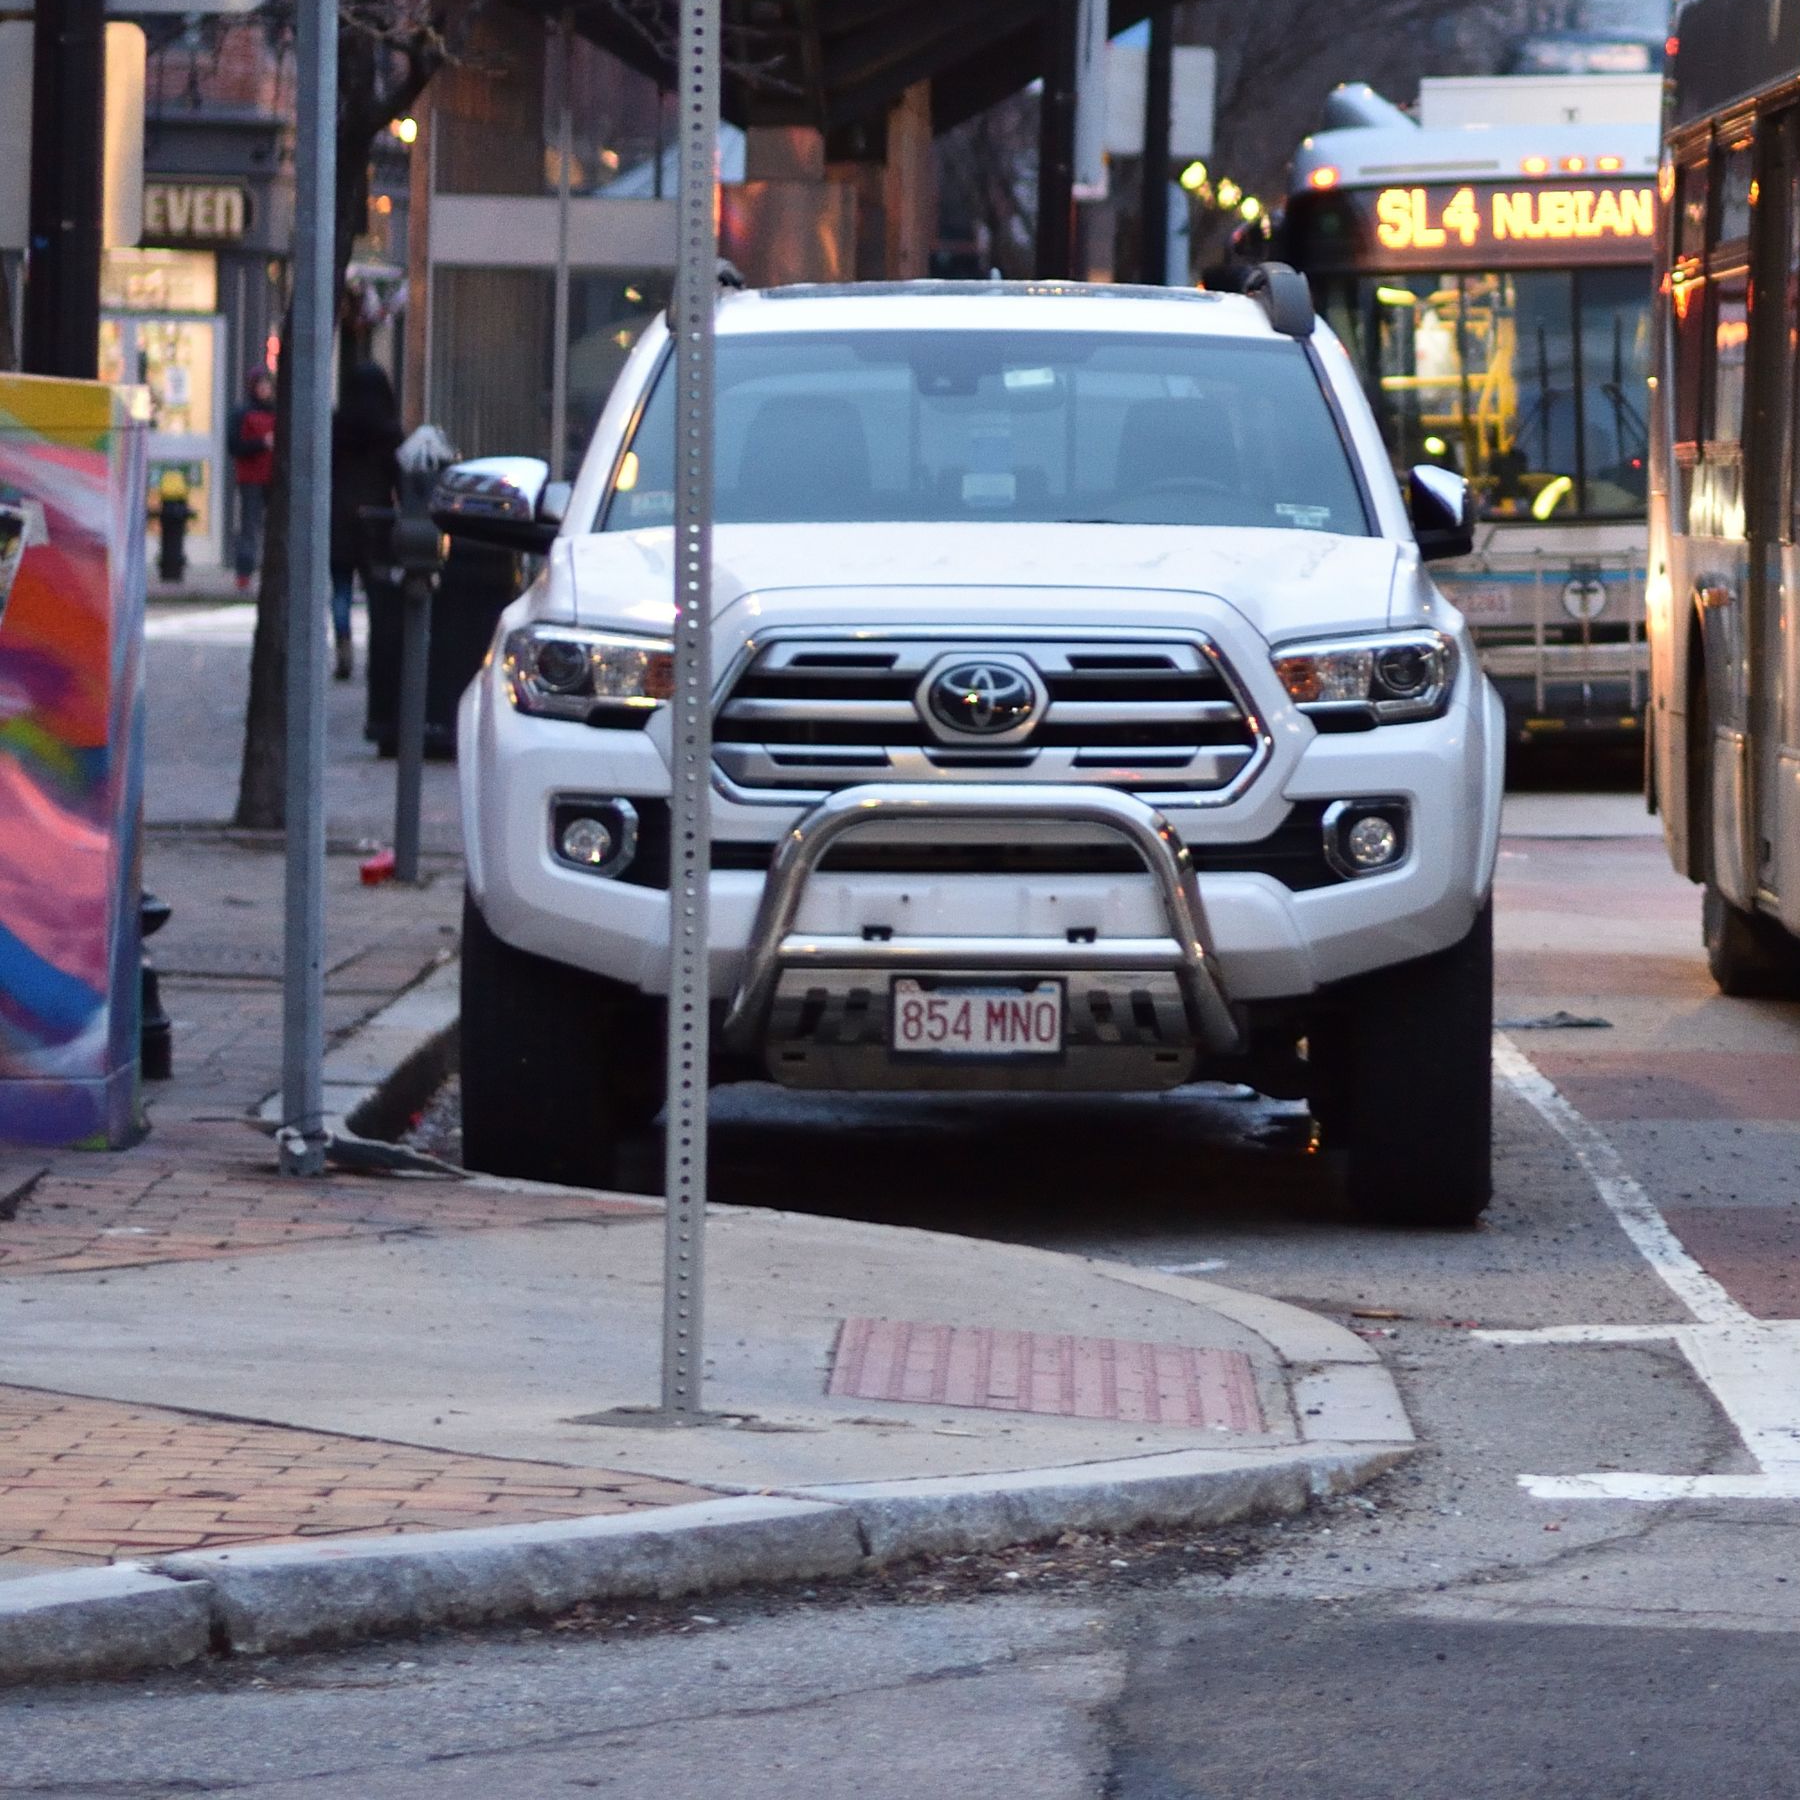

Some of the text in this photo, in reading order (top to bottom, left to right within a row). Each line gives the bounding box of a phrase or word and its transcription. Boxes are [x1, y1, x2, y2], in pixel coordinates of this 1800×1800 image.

[1377, 187, 1654, 248] SL4 NUBIAN
[903, 1001, 971, 1042] 854
